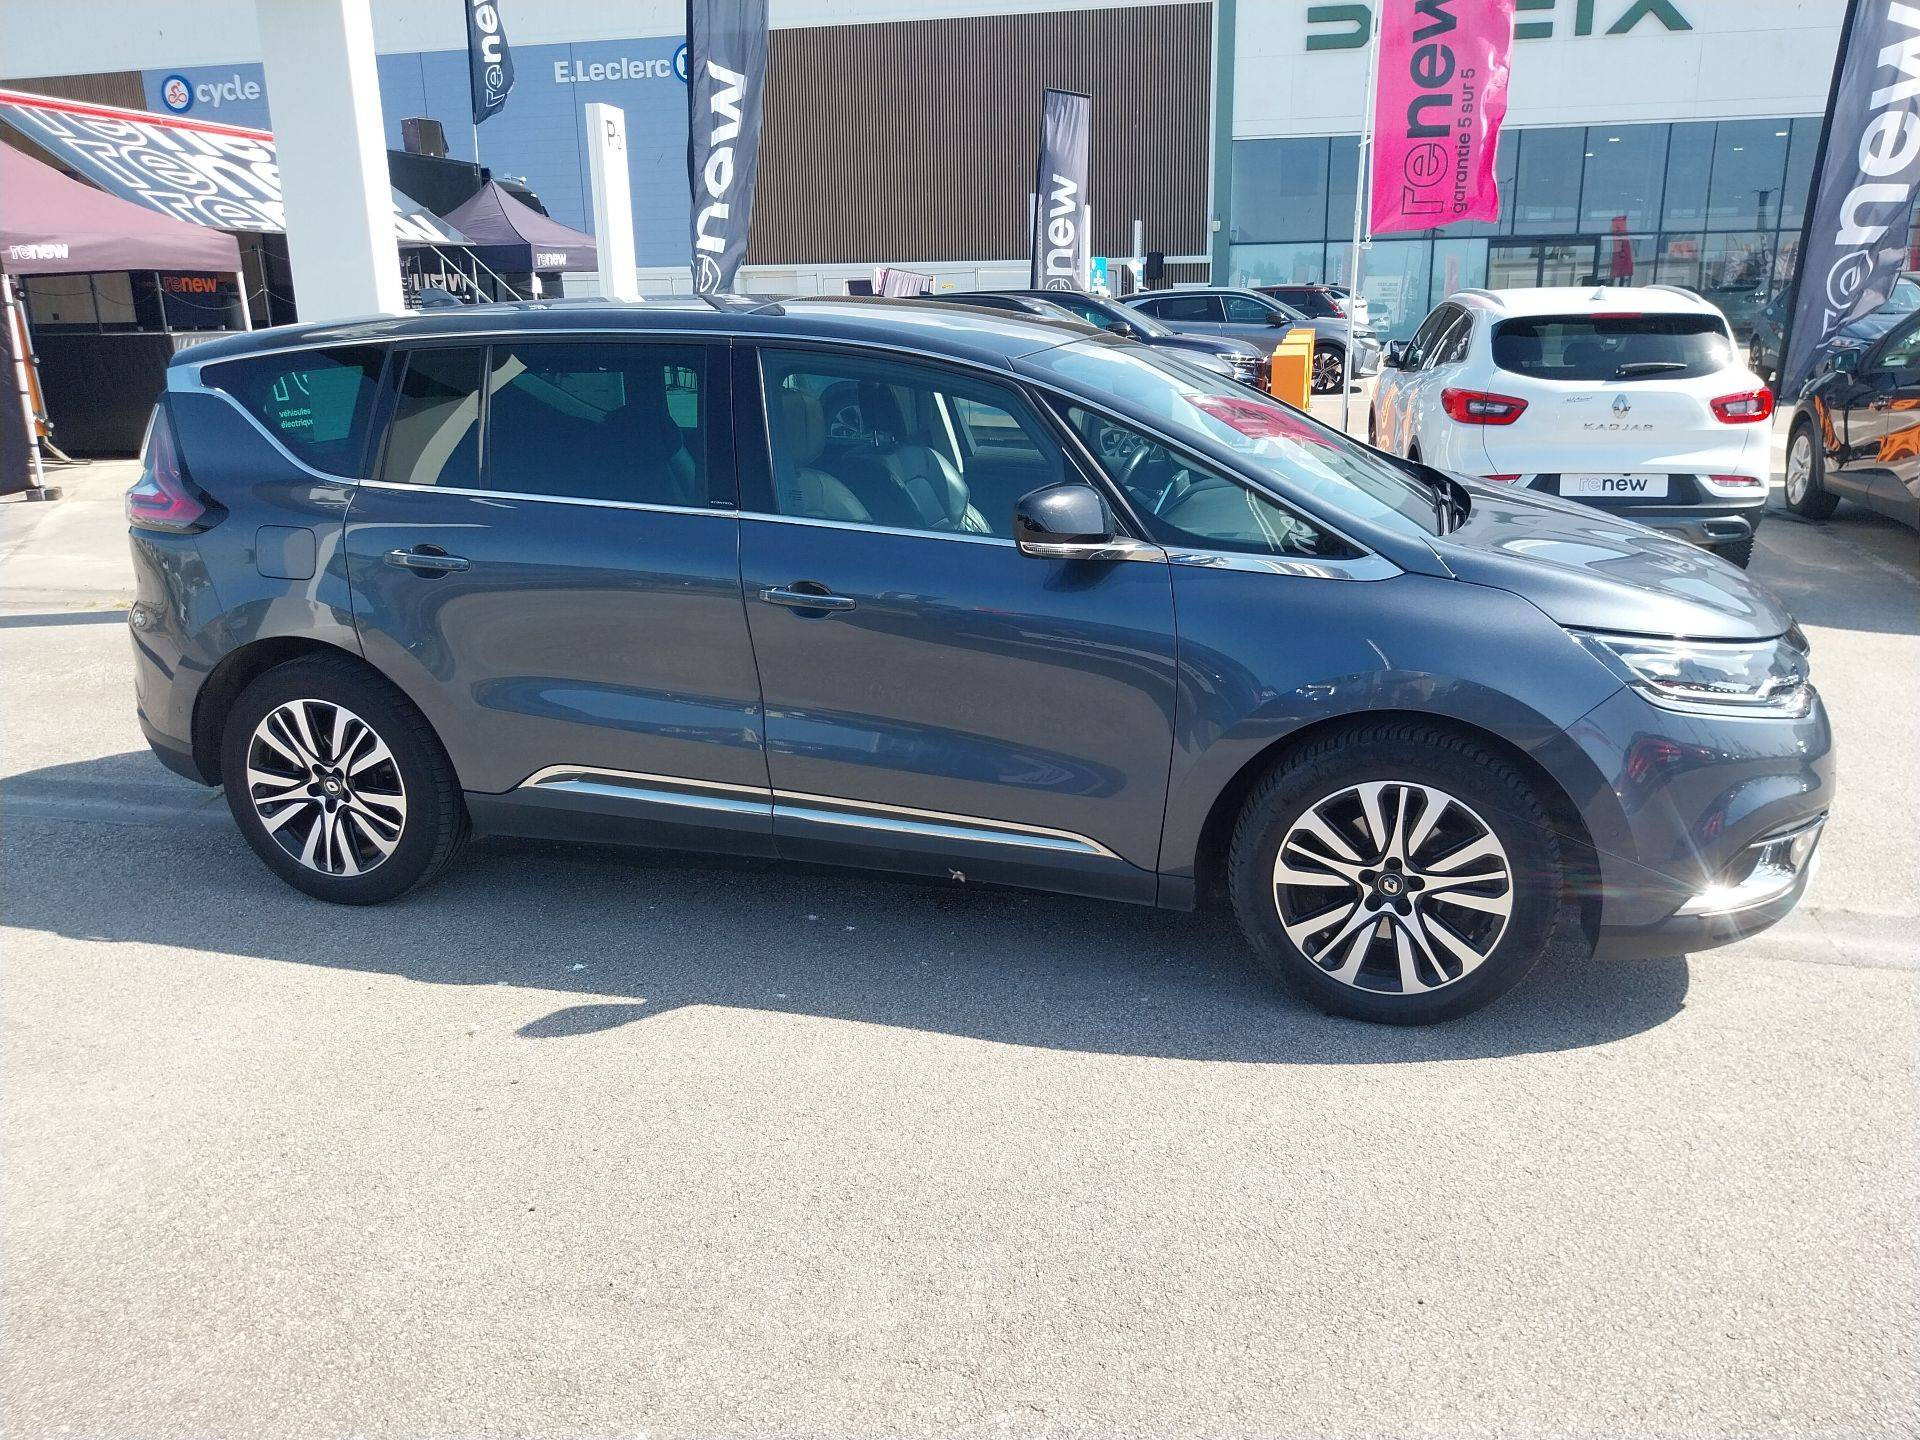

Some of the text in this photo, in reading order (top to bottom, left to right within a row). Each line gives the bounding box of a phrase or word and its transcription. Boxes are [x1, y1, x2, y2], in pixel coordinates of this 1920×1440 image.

[475, 0, 505, 108] rene
[554, 57, 671, 84] E.Leclerc
[196, 75, 261, 107] cycle
[1401, 0, 1458, 216] renew
[1453, 68, 1476, 214] garantie 5 sur 5
[696, 60, 748, 295] enew
[1046, 174, 1078, 290] new
[10, 244, 69, 260] renew
[536, 253, 567, 266] renew
[163, 277, 217, 293] renew
[1583, 423, 1655, 432] KADJAR
[1579, 478, 1648, 492] renew
